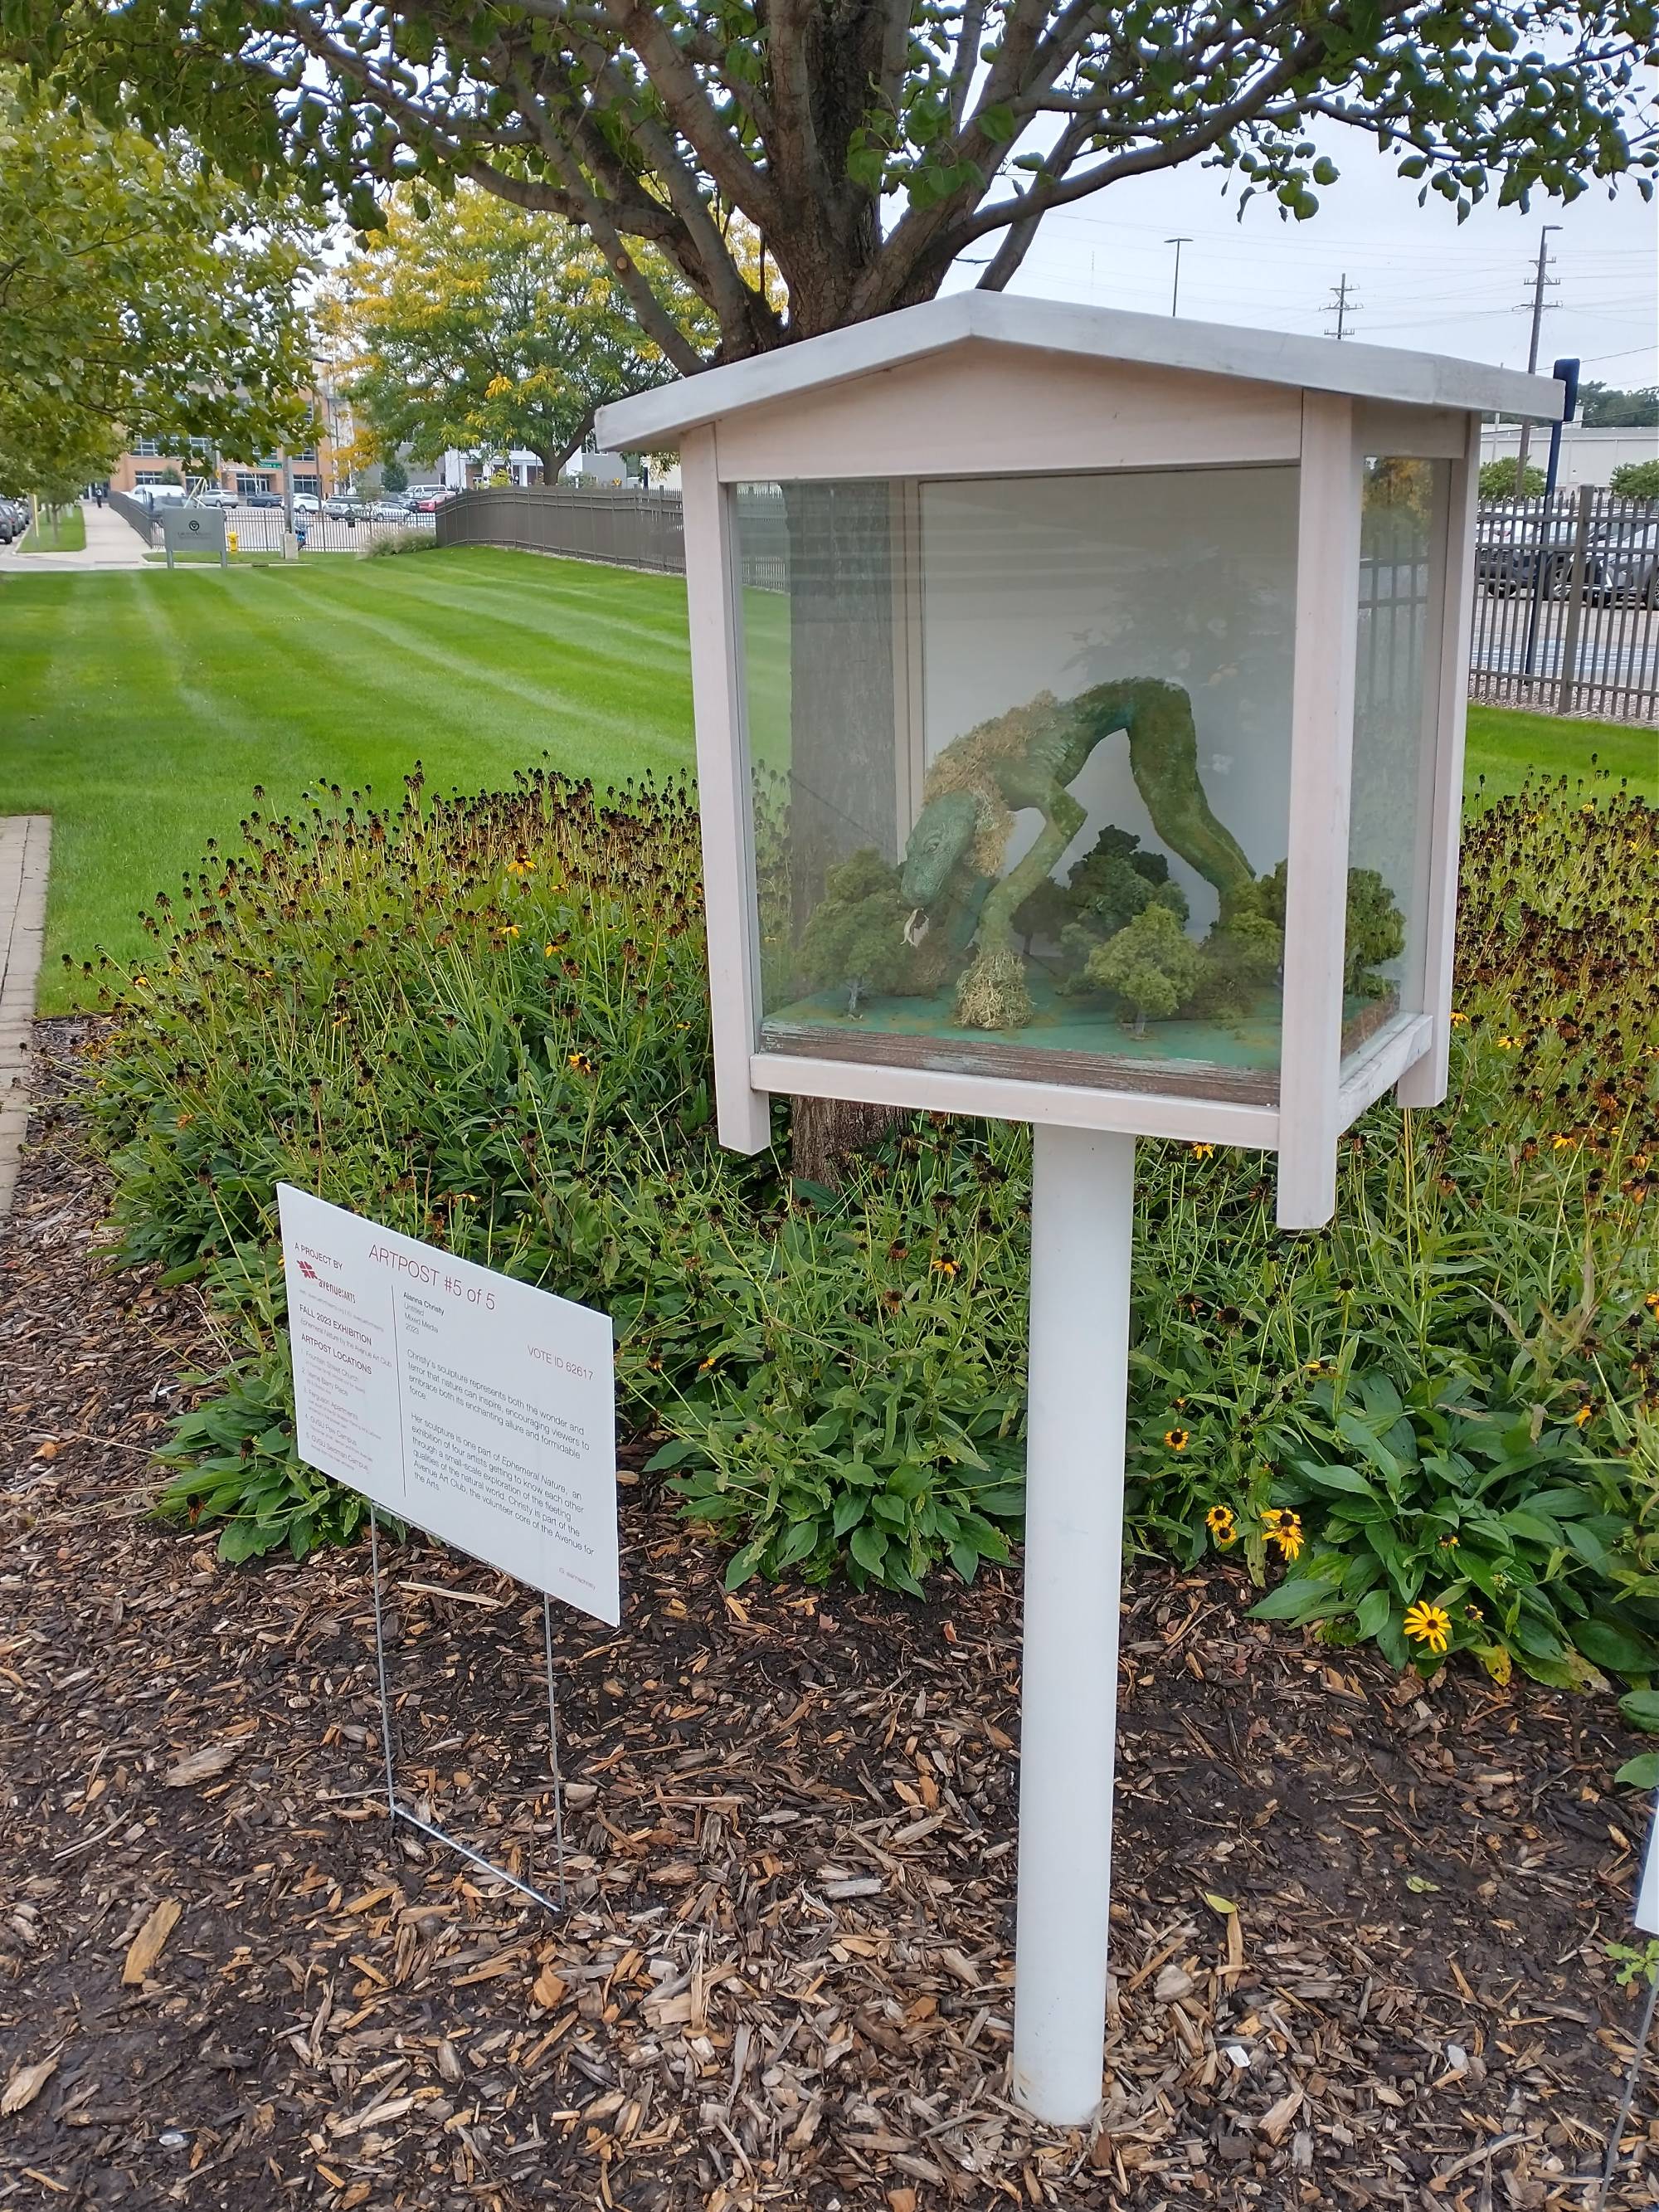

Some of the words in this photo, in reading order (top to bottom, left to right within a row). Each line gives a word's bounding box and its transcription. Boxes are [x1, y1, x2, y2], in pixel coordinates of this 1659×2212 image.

[294, 1242, 299, 1251] A
[300, 1245, 331, 1265] PROJECT
[333, 1259, 343, 1270] BY
[368, 1244, 440, 1286] ARTPOST
[444, 1276, 462, 1297] #5
[467, 1289, 482, 1304] of
[485, 1293, 495, 1310] 5
[299, 1303, 315, 1318] FALL
[316, 1313, 332, 1326] 2023
[333, 1320, 372, 1346] EXHIBITION
[301, 1333, 332, 1354] ARTPOST
[333, 1348, 372, 1375] LOCATIONS
[527, 1345, 552, 1364] VOTE
[554, 1356, 564, 1368] ID
[566, 1362, 593, 1381] 62617
[406, 1348, 436, 1369] Christy's
[437, 1364, 468, 1384] sculpture
[469, 1379, 506, 1401] represents
[508, 1395, 524, 1409] both
[526, 1403, 538, 1415] the
[540, 1411, 567, 1427] wonder
[569, 1424, 584, 1435] and
[408, 1362, 426, 1375] terror
[426, 1371, 440, 1382] that
[441, 1378, 463, 1393] nature
[464, 1389, 477, 1400] can
[479, 1395, 504, 1413] inspire,
[505, 1408, 550, 1435] encouraging
[552, 1429, 580, 1446] viewers
[581, 1440, 590, 1450] to
[409, 1375, 438, 1393] embrace
[439, 1386, 455, 1401] both
[455, 1396, 465, 1406] its
[465, 1401, 504, 1426] enchanting
[505, 1420, 524, 1434] allure
[525, 1429, 539, 1441] and
[541, 1435, 581, 1459] formidable
[411, 1412, 423, 1424] Her
[424, 1420, 455, 1440] sculpture
[455, 1435, 462, 1444] is
[463, 1439, 476, 1450] one
[478, 1446, 491, 1458] part
[493, 1454, 500, 1462] of
[501, 1455, 540, 1481] Ephemeral
[572, 1491, 581, 1500] an
[411, 1425, 442, 1445] exhibition
[443, 1441, 450, 1449] of
[452, 1444, 465, 1455] four
[466, 1453, 488, 1468] artists
[489, 1463, 513, 1482] getting
[514, 1474, 522, 1484] to
[523, 1478, 543, 1494] know
[544, 1490, 563, 1504] each
[564, 1500, 584, 1513] other
[412, 1436, 437, 1454] through
[445, 1454, 482, 1477] small-scale
[483, 1473, 521, 1496] exploration
[523, 1492, 530, 1501] of
[532, 1495, 543, 1508] the
[545, 1501, 572, 1523] fleeting
[413, 1449, 440, 1468] qualities
[440, 1463, 447, 1471] of
[449, 1466, 460, 1478] the
[460, 1474, 484, 1489] natural
[508, 1495, 533, 1516] Christy
[534, 1509, 541, 1518] is
[542, 1513, 557, 1526] part
[558, 1522, 566, 1530] of
[567, 1524, 580, 1537] the
[414, 1471, 425, 1483] the
[413, 1459, 438, 1478] Avenue
[439, 1473, 449, 1484] Art
[450, 1478, 468, 1494] Club,
[469, 1488, 481, 1500] the
[482, 1496, 513, 1516] volunteer
[514, 1513, 531, 1525] core
[532, 1521, 539, 1529] of
[541, 1524, 553, 1537] the
[554, 1531, 582, 1551] Avenue
[584, 1544, 595, 1556] for
